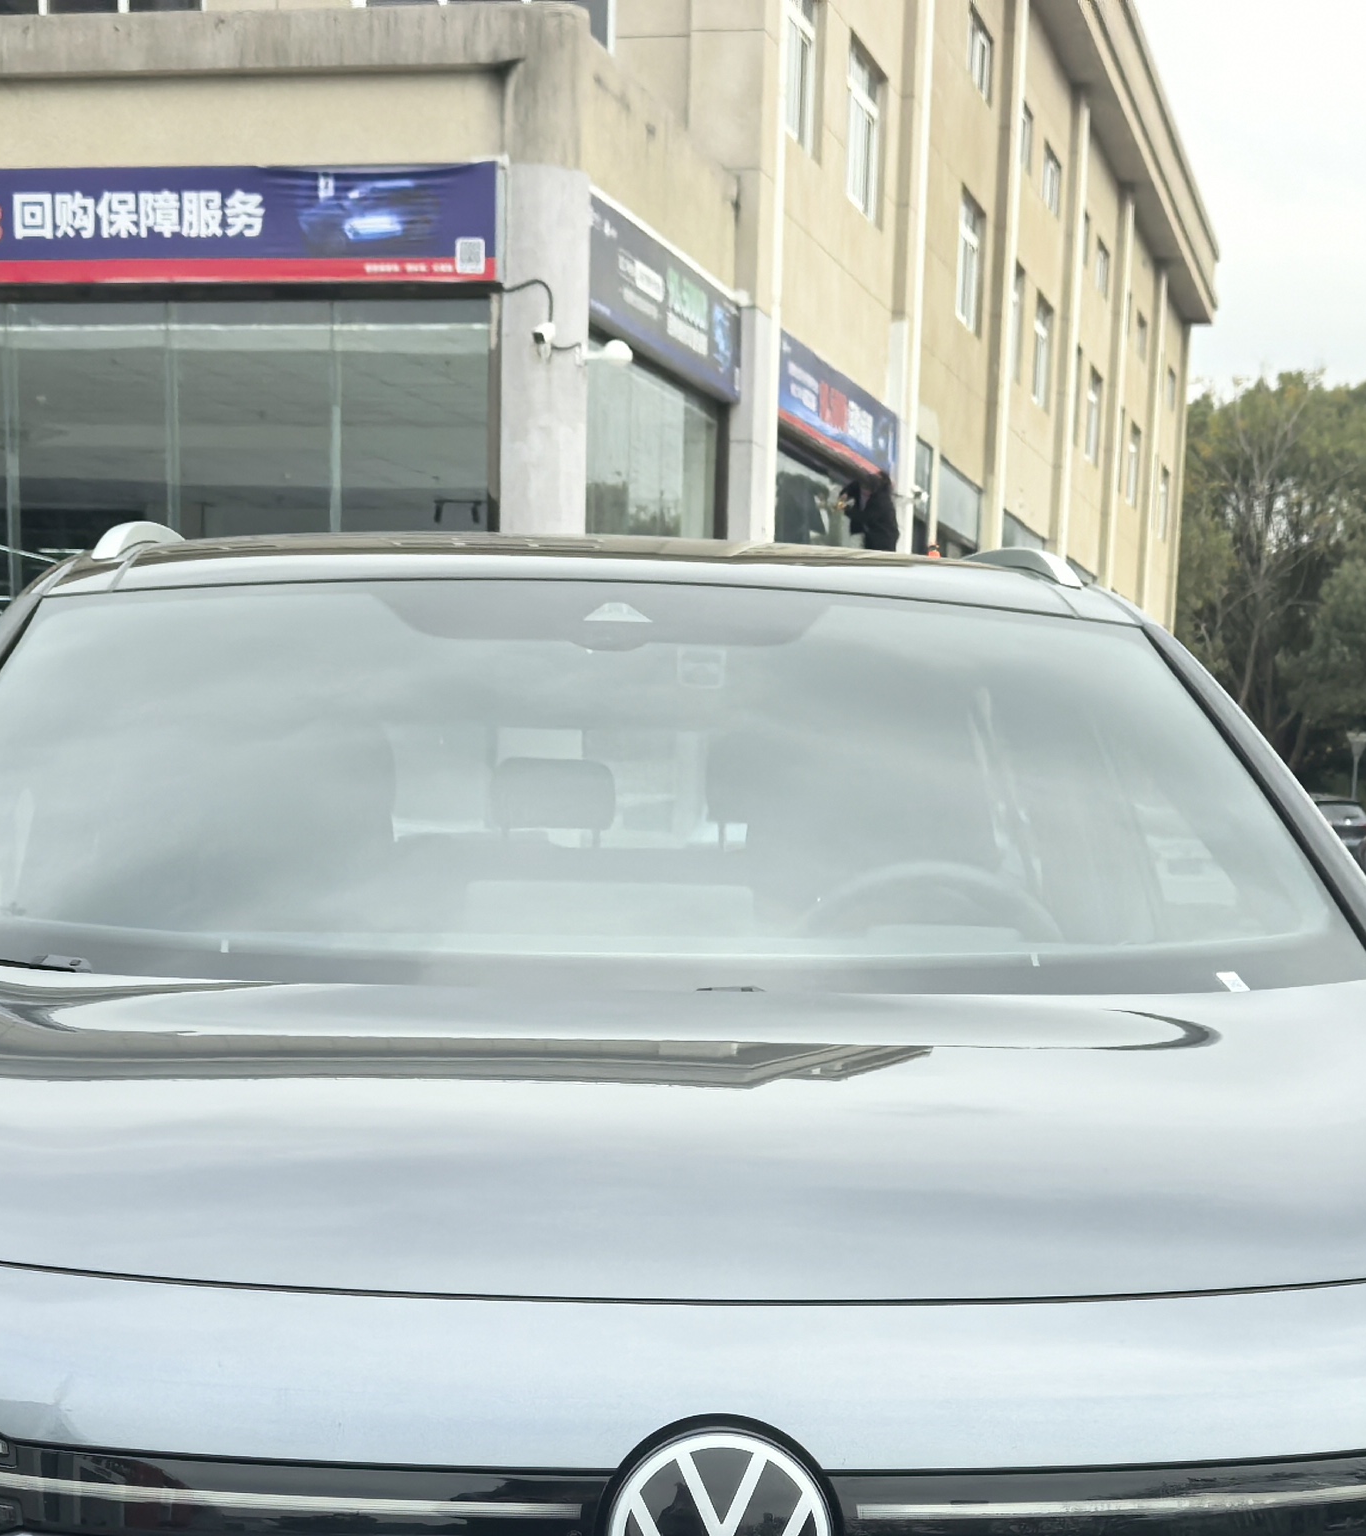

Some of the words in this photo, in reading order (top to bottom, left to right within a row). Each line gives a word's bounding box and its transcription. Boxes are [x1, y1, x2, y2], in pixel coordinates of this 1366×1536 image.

[12, 188, 266, 240] 回购保障服务
